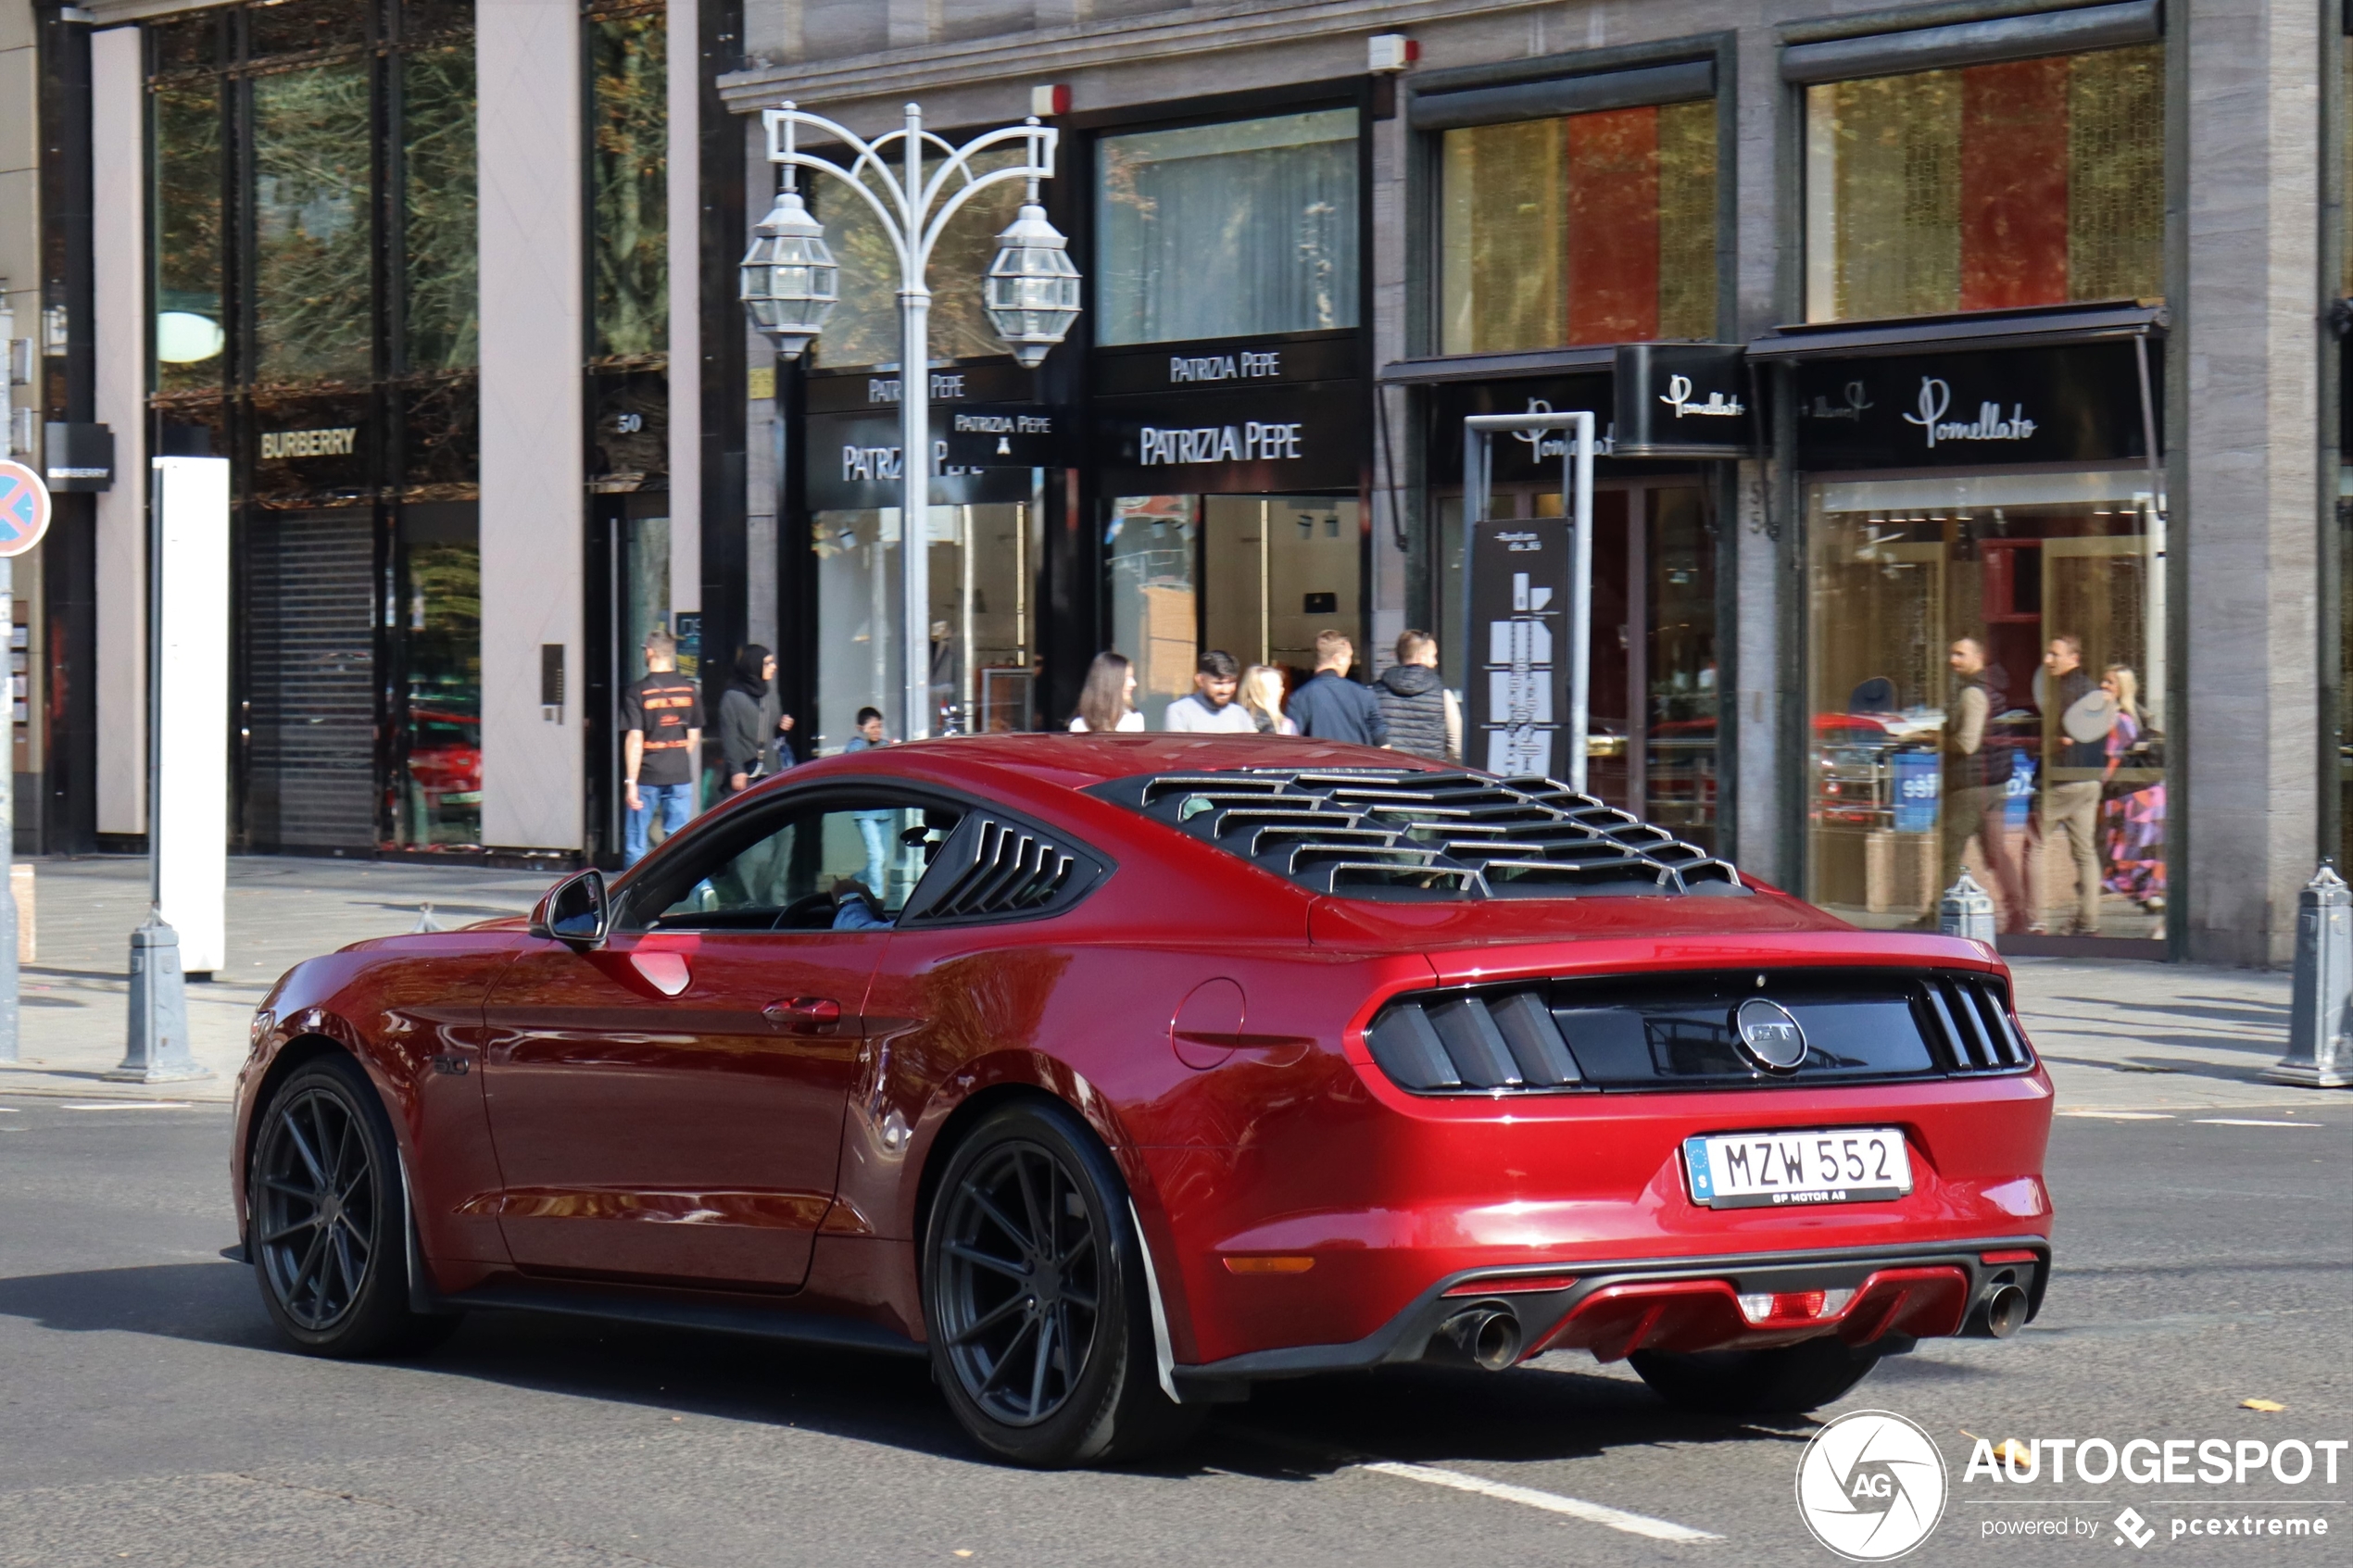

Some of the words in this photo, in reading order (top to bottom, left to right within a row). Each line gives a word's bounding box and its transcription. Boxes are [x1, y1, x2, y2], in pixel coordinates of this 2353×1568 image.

[1170, 357, 1238, 383] PATRIZIA
[1240, 352, 1280, 377] PEPE
[868, 378, 901, 403] PATR
[930, 374, 965, 398] PEPE
[618, 414, 641, 433] 50
[955, 415, 1014, 433] PATRIZIA
[1017, 416, 1051, 433] PEPE
[1902, 376, 2037, 448] Pomellato
[260, 428, 357, 459] BURBERRY
[1140, 426, 1245, 466] PATRIZIA
[1245, 421, 1302, 460] PEPE
[1725, 1141, 1804, 1187] MZW
[1817, 1139, 1892, 1182] 552
[1792, 1191, 1829, 1202] MOTOR
